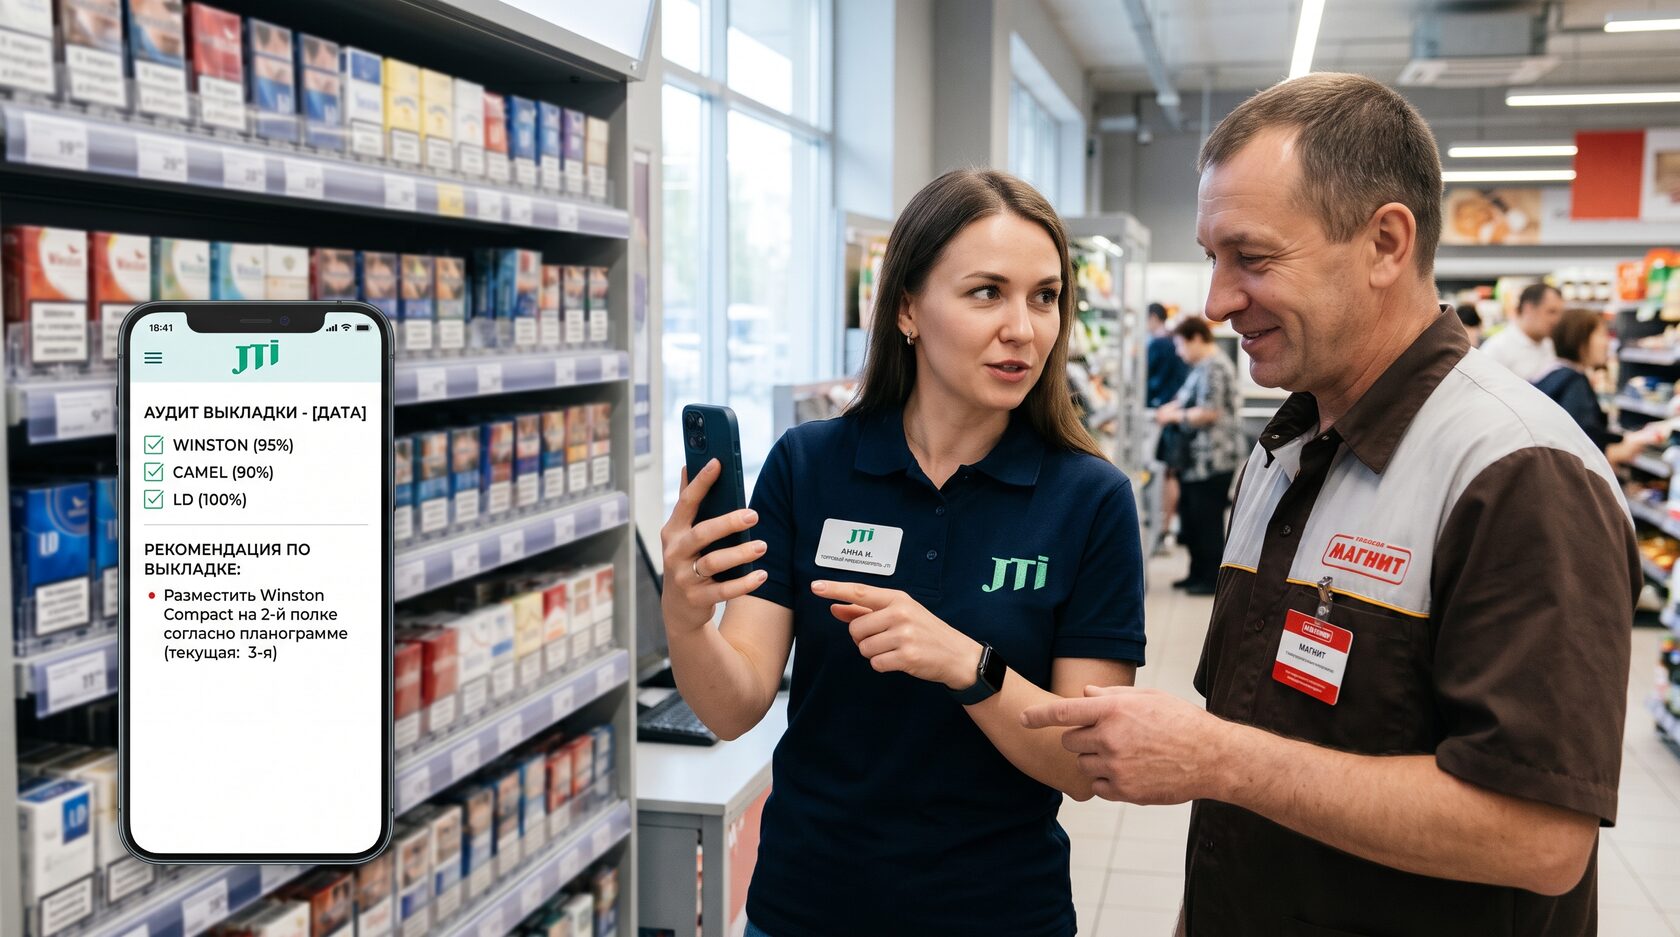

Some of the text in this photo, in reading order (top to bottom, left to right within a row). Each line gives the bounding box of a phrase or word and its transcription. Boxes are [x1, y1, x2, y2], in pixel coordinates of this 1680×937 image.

[149, 323, 173, 332] 18:41
[144, 406, 199, 422] АУДИТ
[203, 406, 298, 422] ВЫКЛАДКИ
[312, 406, 367, 422] [ДАТА]
[173, 438, 294, 454] WINSTON (95%)
[172, 466, 274, 482] CAMEL (90%)
[173, 493, 247, 509] LD (100%)
[144, 543, 311, 558] РЕКОМЕНДАЦИЯ ПО
[841, 548, 864, 557] АННА
[1328, 542, 1406, 576] МАГНИТ
[144, 563, 241, 577] ВЫКЛАДКЕ:
[164, 588, 325, 602] Разместить Winston
[164, 607, 338, 623] Compact на 2-й полке
[164, 629, 348, 643] согласно планограмме
[164, 645, 277, 662] (текущая: 3-я)
[1298, 642, 1327, 660] МАГНИТ
